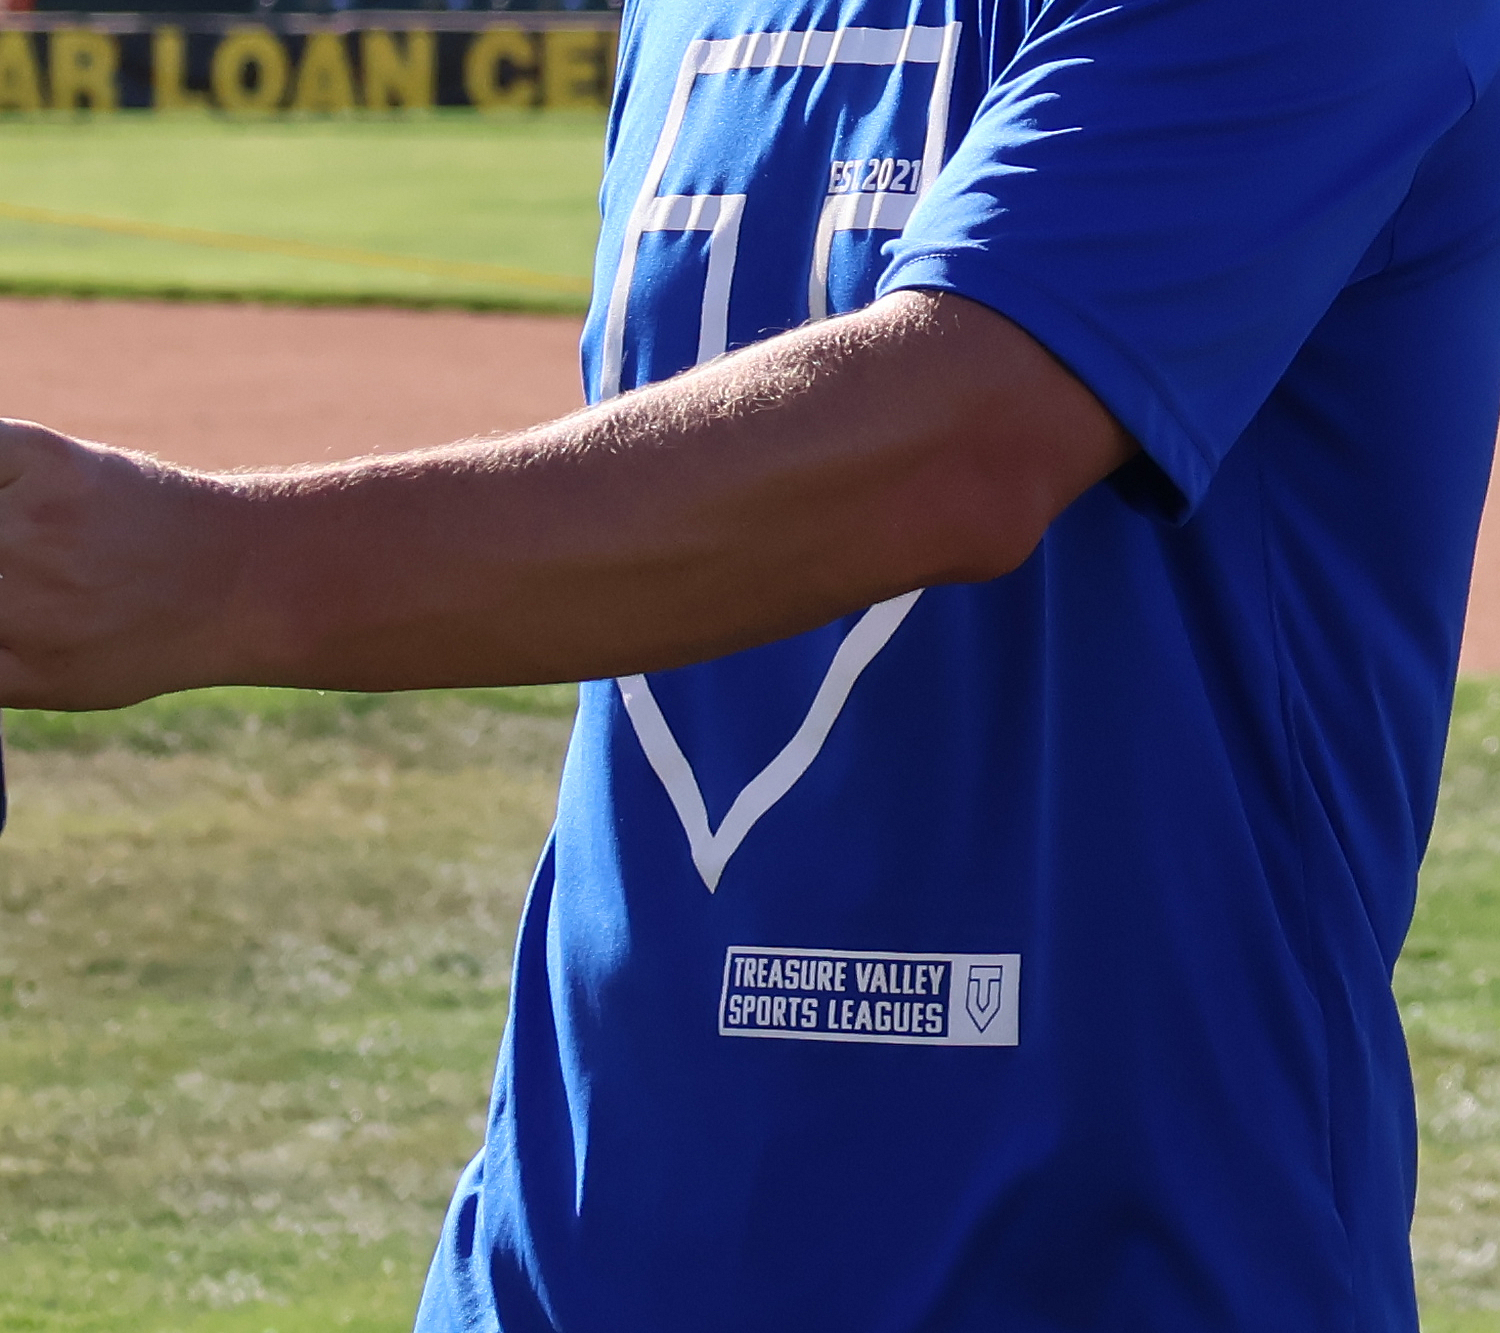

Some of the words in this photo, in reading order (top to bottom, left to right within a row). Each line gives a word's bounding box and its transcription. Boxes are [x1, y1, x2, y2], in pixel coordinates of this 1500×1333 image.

[152, 25, 434, 113] LOAN
[463, 23, 616, 113] CE
[861, 157, 921, 192] 2021
[734, 957, 848, 992] TREASURE
[855, 962, 945, 995] VALLEY
[728, 995, 819, 1028] SPORTS
[827, 999, 944, 1034] LEAGUES
